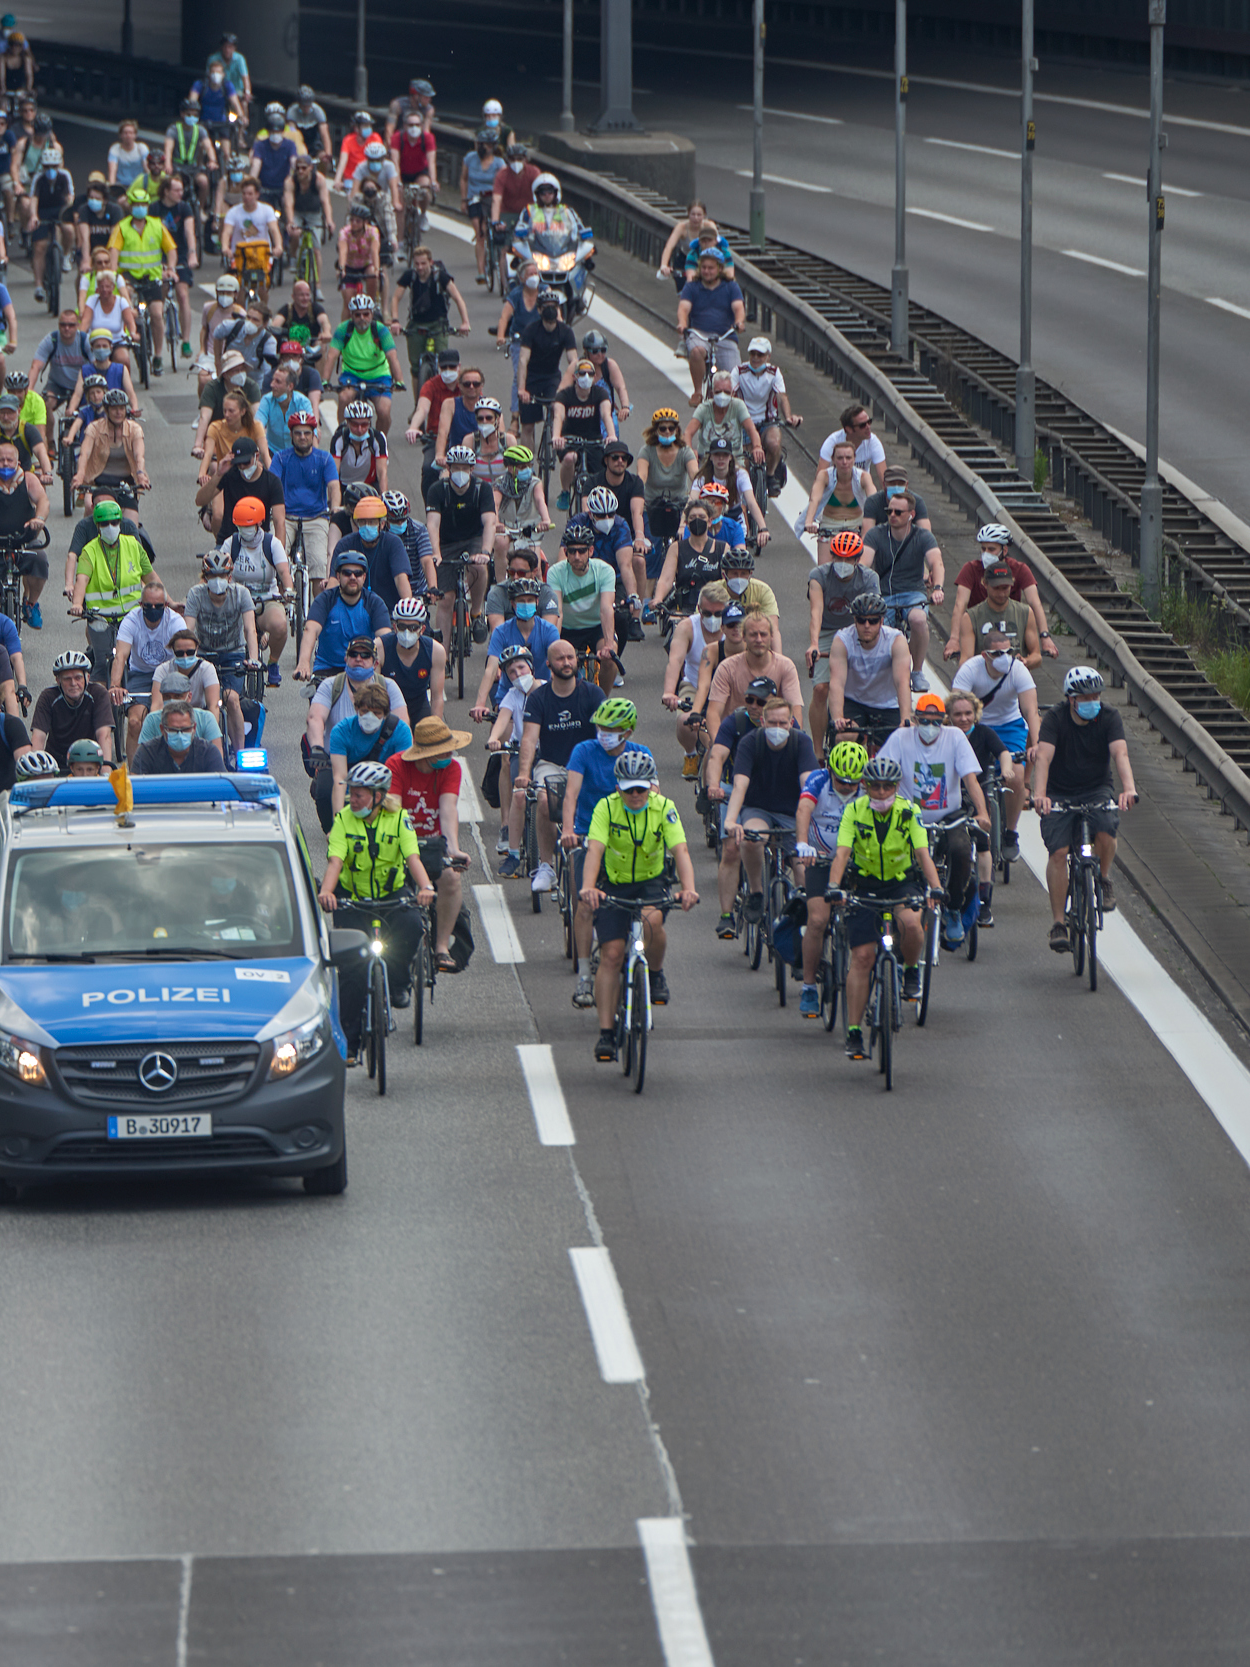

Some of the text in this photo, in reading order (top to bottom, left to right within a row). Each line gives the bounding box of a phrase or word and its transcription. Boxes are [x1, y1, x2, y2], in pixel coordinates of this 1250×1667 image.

[243, 971, 285, 981] OV 2
[82, 987, 230, 1007] POLIZEI
[126, 1117, 201, 1134] B 30917
